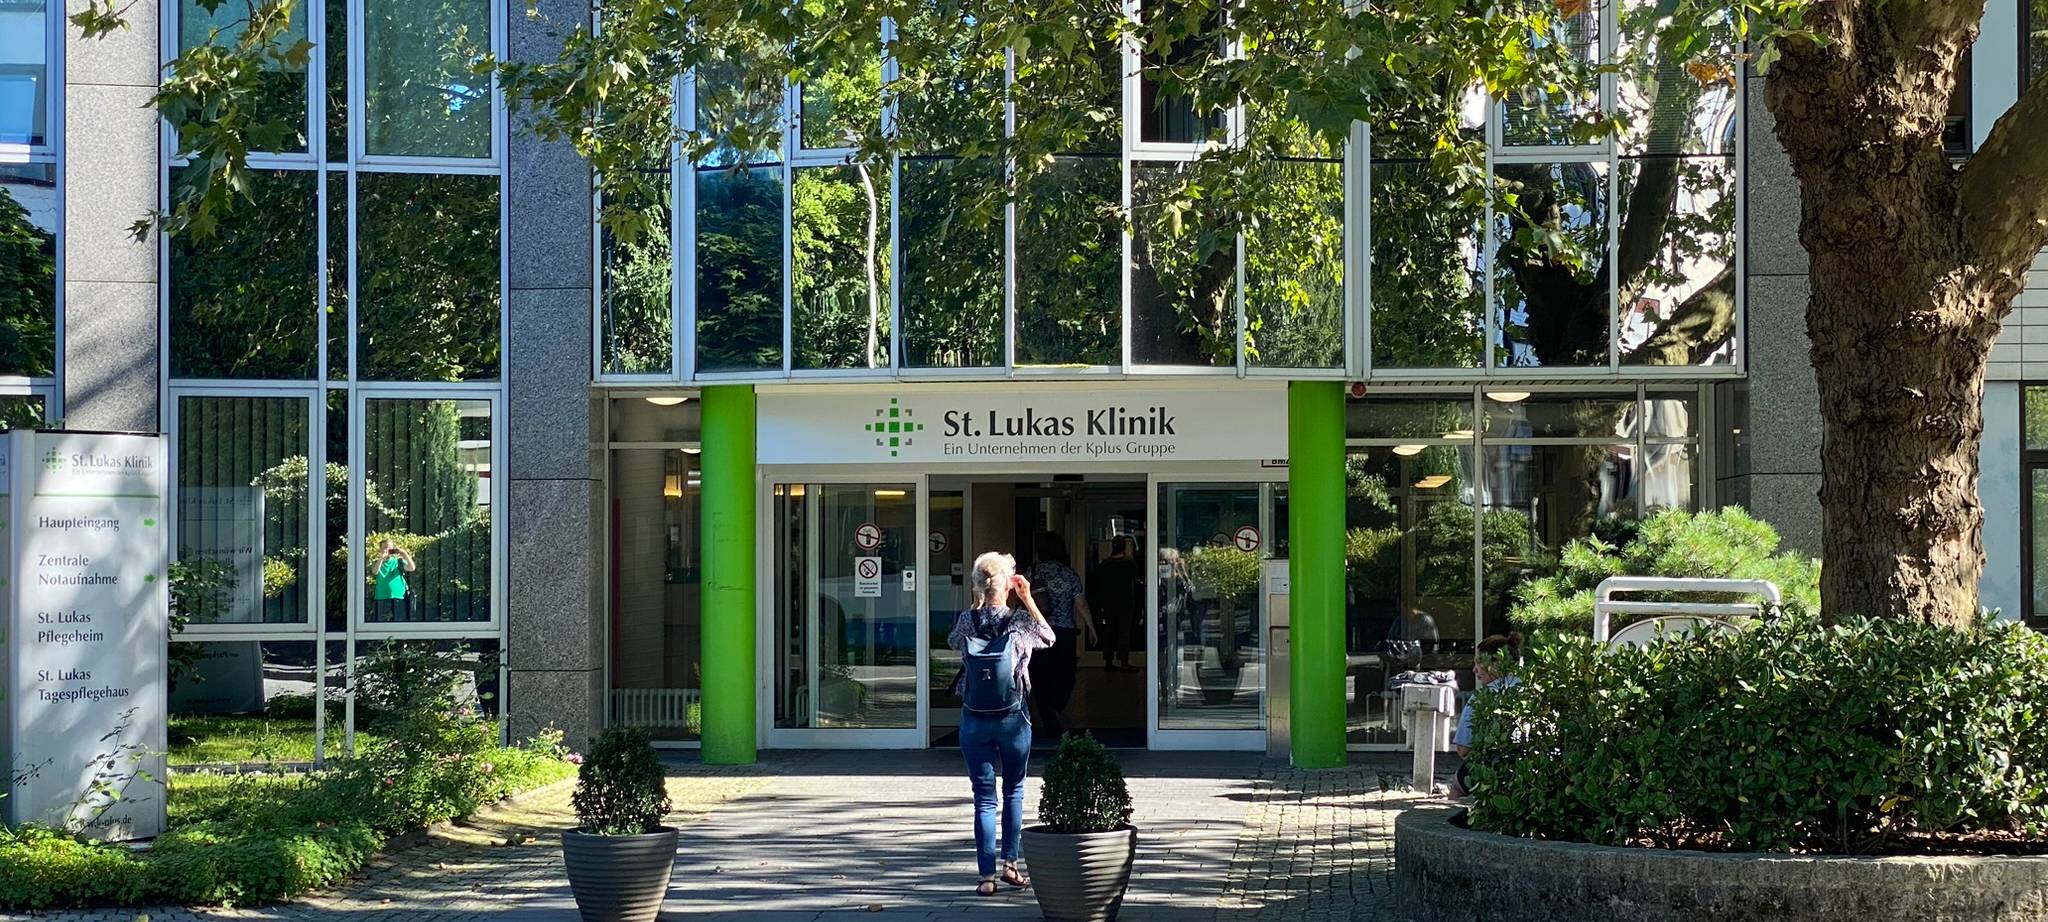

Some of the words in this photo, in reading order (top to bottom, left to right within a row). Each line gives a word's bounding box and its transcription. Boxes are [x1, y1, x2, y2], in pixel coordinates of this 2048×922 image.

[944, 410, 981, 437] St.
[989, 407, 1075, 437] Lukas
[1087, 406, 1176, 436] Klinik
[944, 442, 963, 456] Ein
[968, 441, 1056, 455] Unternehmen
[1060, 441, 1082, 455] der
[1086, 441, 1122, 457] Kplus
[1126, 441, 1176, 457] Gruppe
[71, 453, 88, 467] St.
[89, 453, 122, 468] Lukas
[124, 455, 153, 469] Klinik
[39, 515, 120, 532] Haupteingang
[39, 554, 89, 567] Zentrale
[39, 572, 118, 585] Notaufnahme
[38, 612, 54, 624] St.
[58, 610, 91, 624] Lukas
[38, 629, 104, 646] Pflegeheim
[38, 669, 54, 682] St.
[58, 668, 92, 681] Lukas
[38, 685, 129, 704] Tagespflegehaus
